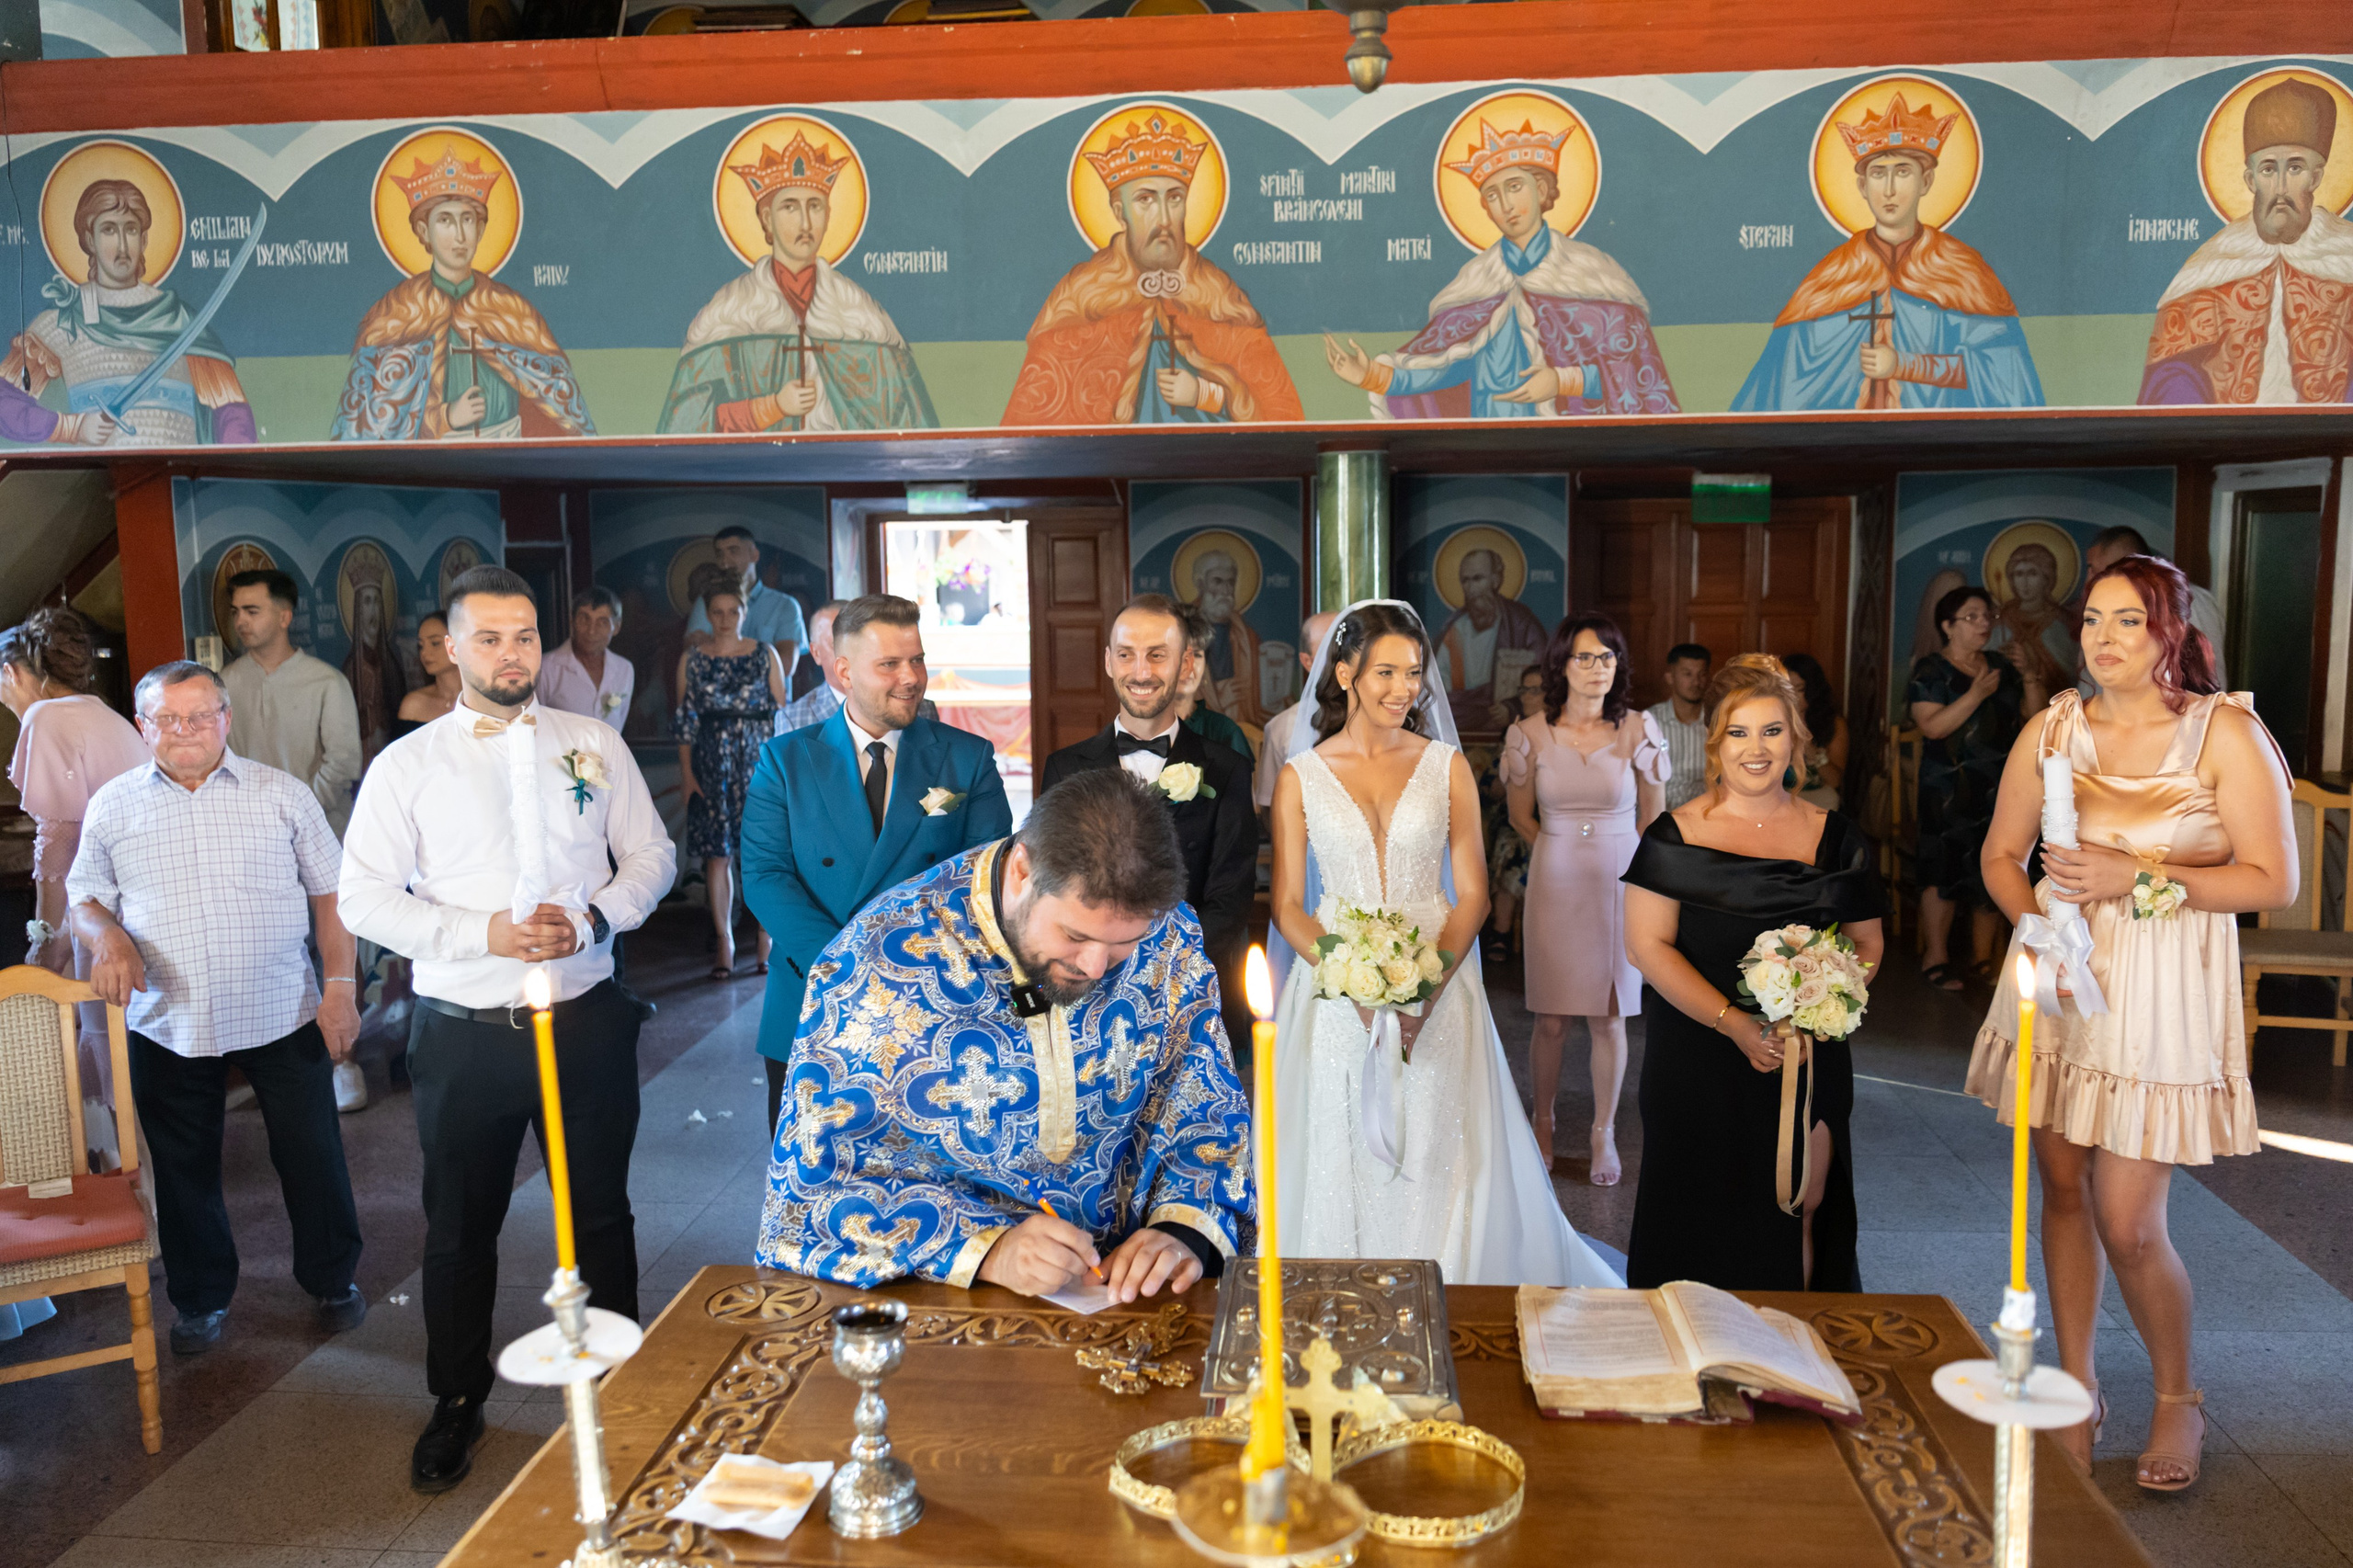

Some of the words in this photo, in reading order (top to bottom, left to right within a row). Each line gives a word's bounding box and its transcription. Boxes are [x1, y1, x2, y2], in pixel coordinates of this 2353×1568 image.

[864, 245, 948, 275] CONSTANTIN
[1233, 241, 1322, 266] CONSTANTIN
[1387, 234, 1432, 262] MATEI
